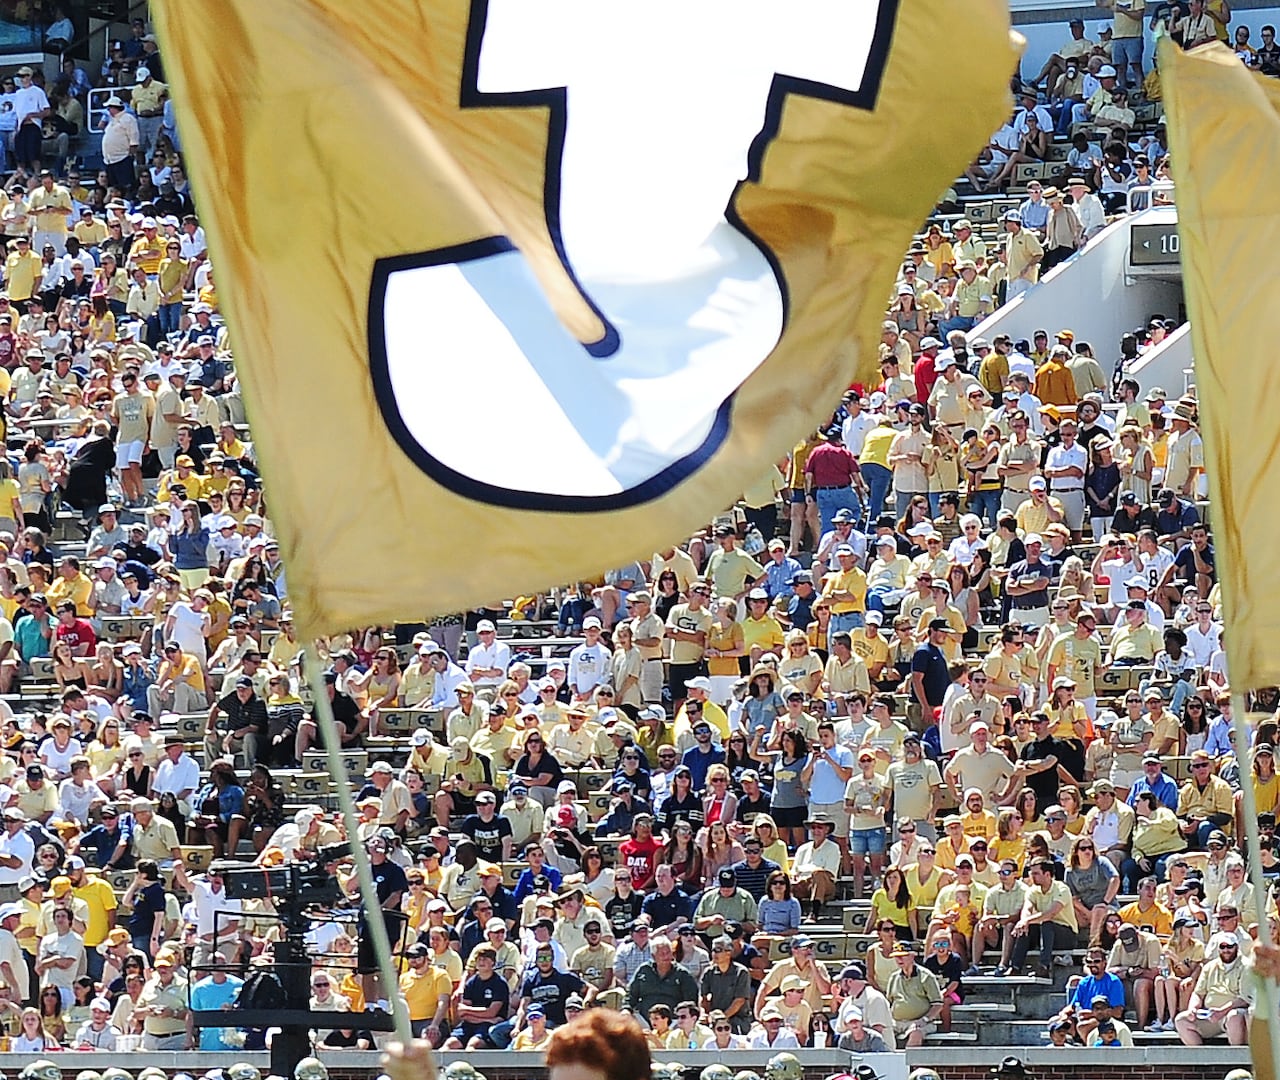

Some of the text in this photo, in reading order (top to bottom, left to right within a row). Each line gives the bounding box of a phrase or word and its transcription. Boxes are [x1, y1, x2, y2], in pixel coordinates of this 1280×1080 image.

[1161, 234, 1179, 253] 10
[368, 0, 903, 512] J
[1149, 570, 1158, 587] 8
[108, 623, 123, 632] GT
[677, 616, 697, 631] GT
[580, 653, 595, 663] GT
[1103, 672, 1121, 684] GT
[183, 721, 200, 732] GT
[386, 717, 402, 726] GT
[417, 717, 434, 726] GT
[303, 780, 321, 791] GT
[188, 853, 203, 864] GT
[628, 856, 648, 866] DAY.
[114, 876, 130, 886] GT
[818, 942, 835, 954] GT
